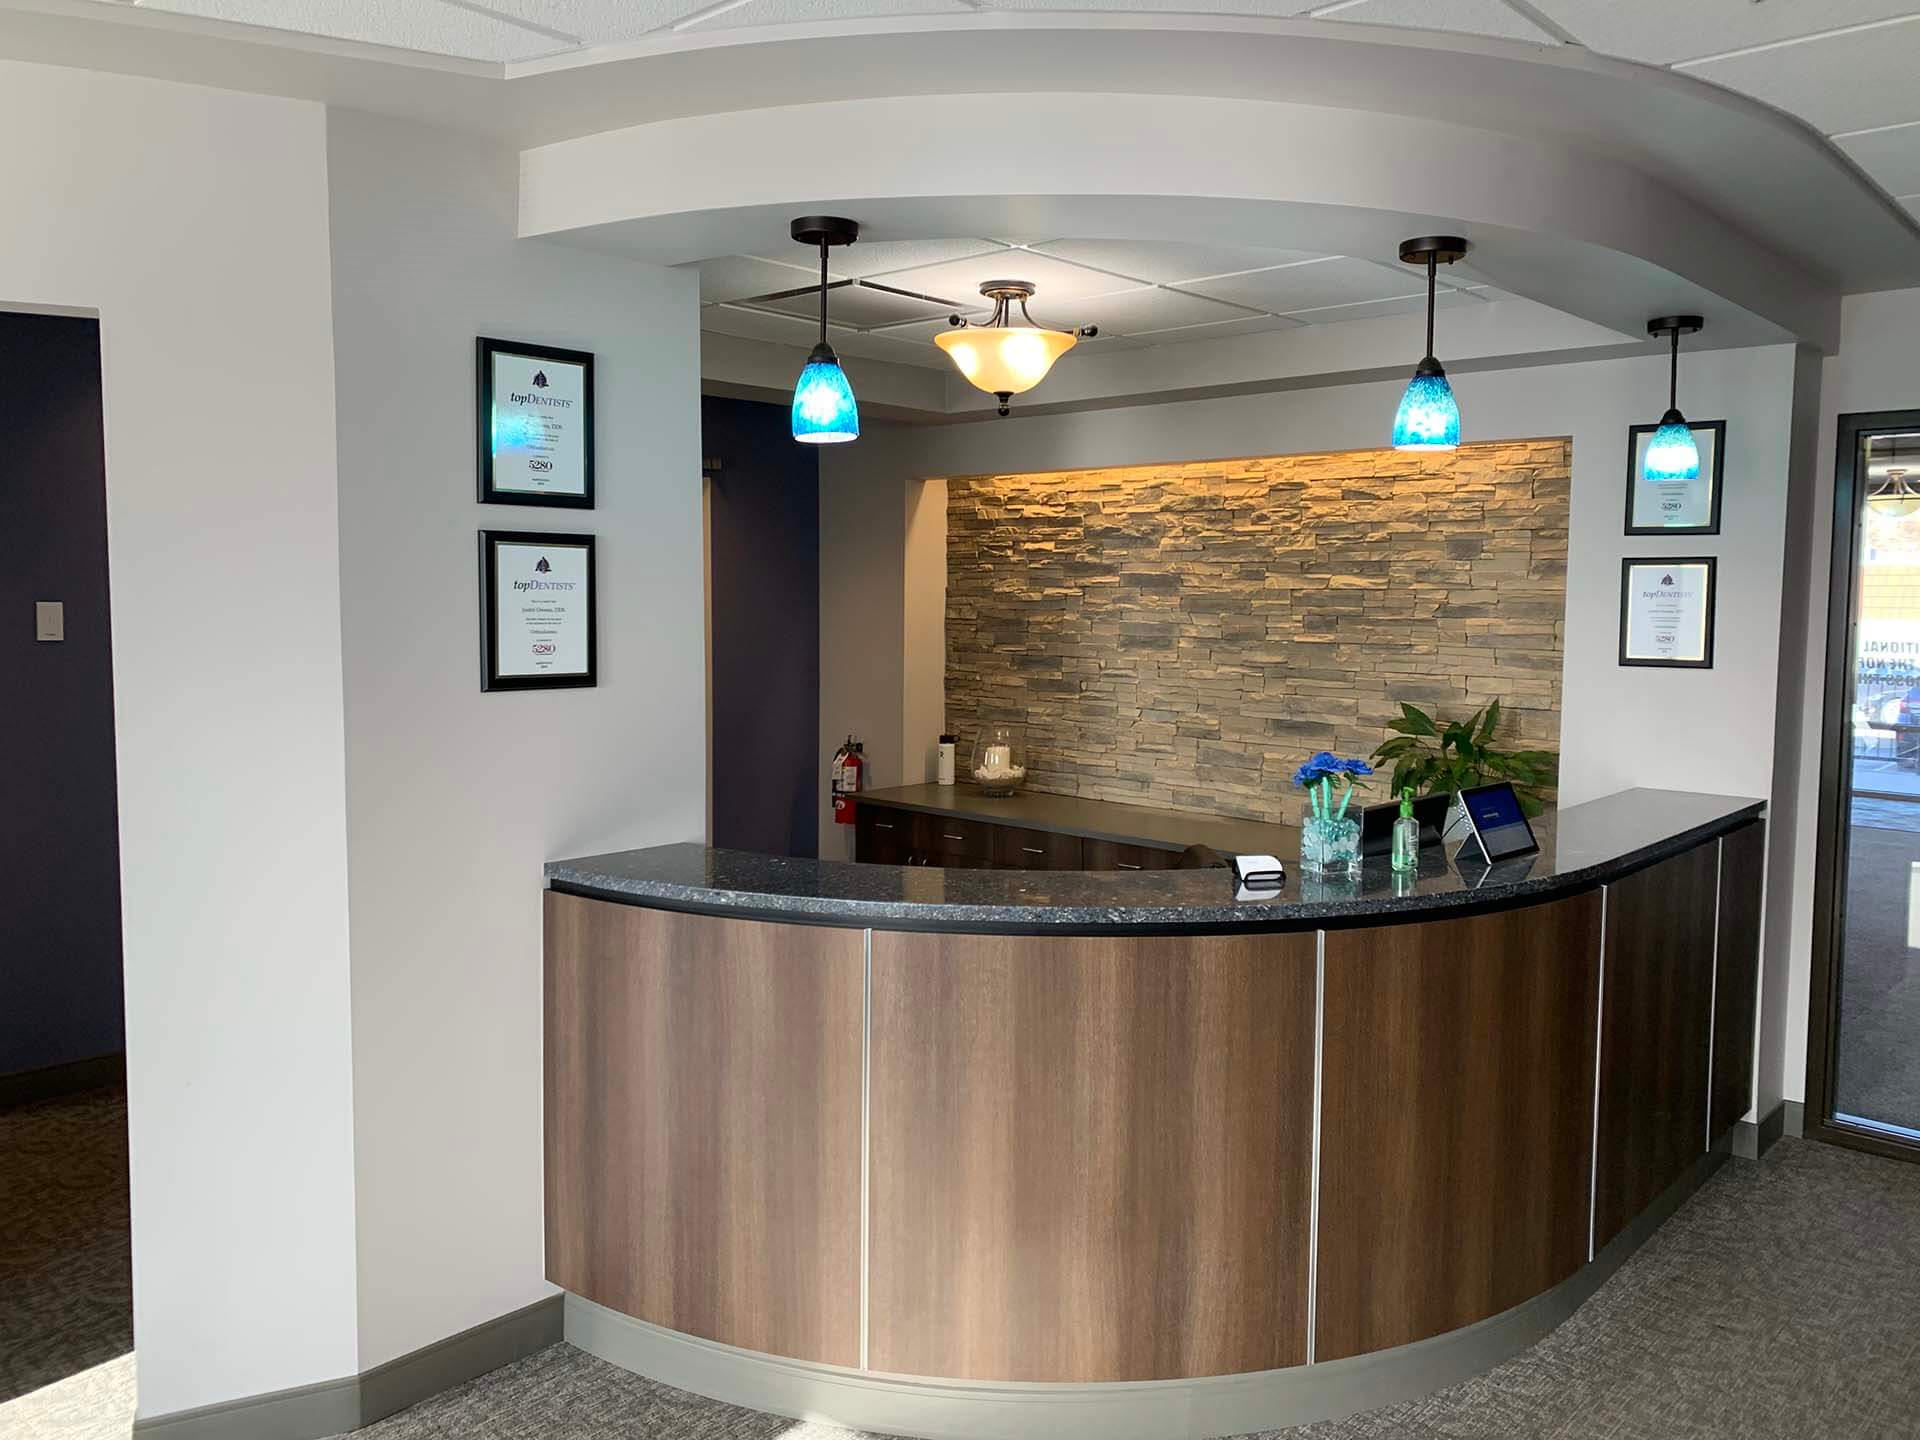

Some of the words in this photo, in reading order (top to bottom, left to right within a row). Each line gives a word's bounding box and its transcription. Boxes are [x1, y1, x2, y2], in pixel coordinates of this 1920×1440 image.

[510, 392, 572, 409] topDENTISTS
[529, 460, 552, 470] 5280
[513, 579, 575, 593] topDENTISTS
[531, 643, 556, 654] 5280
